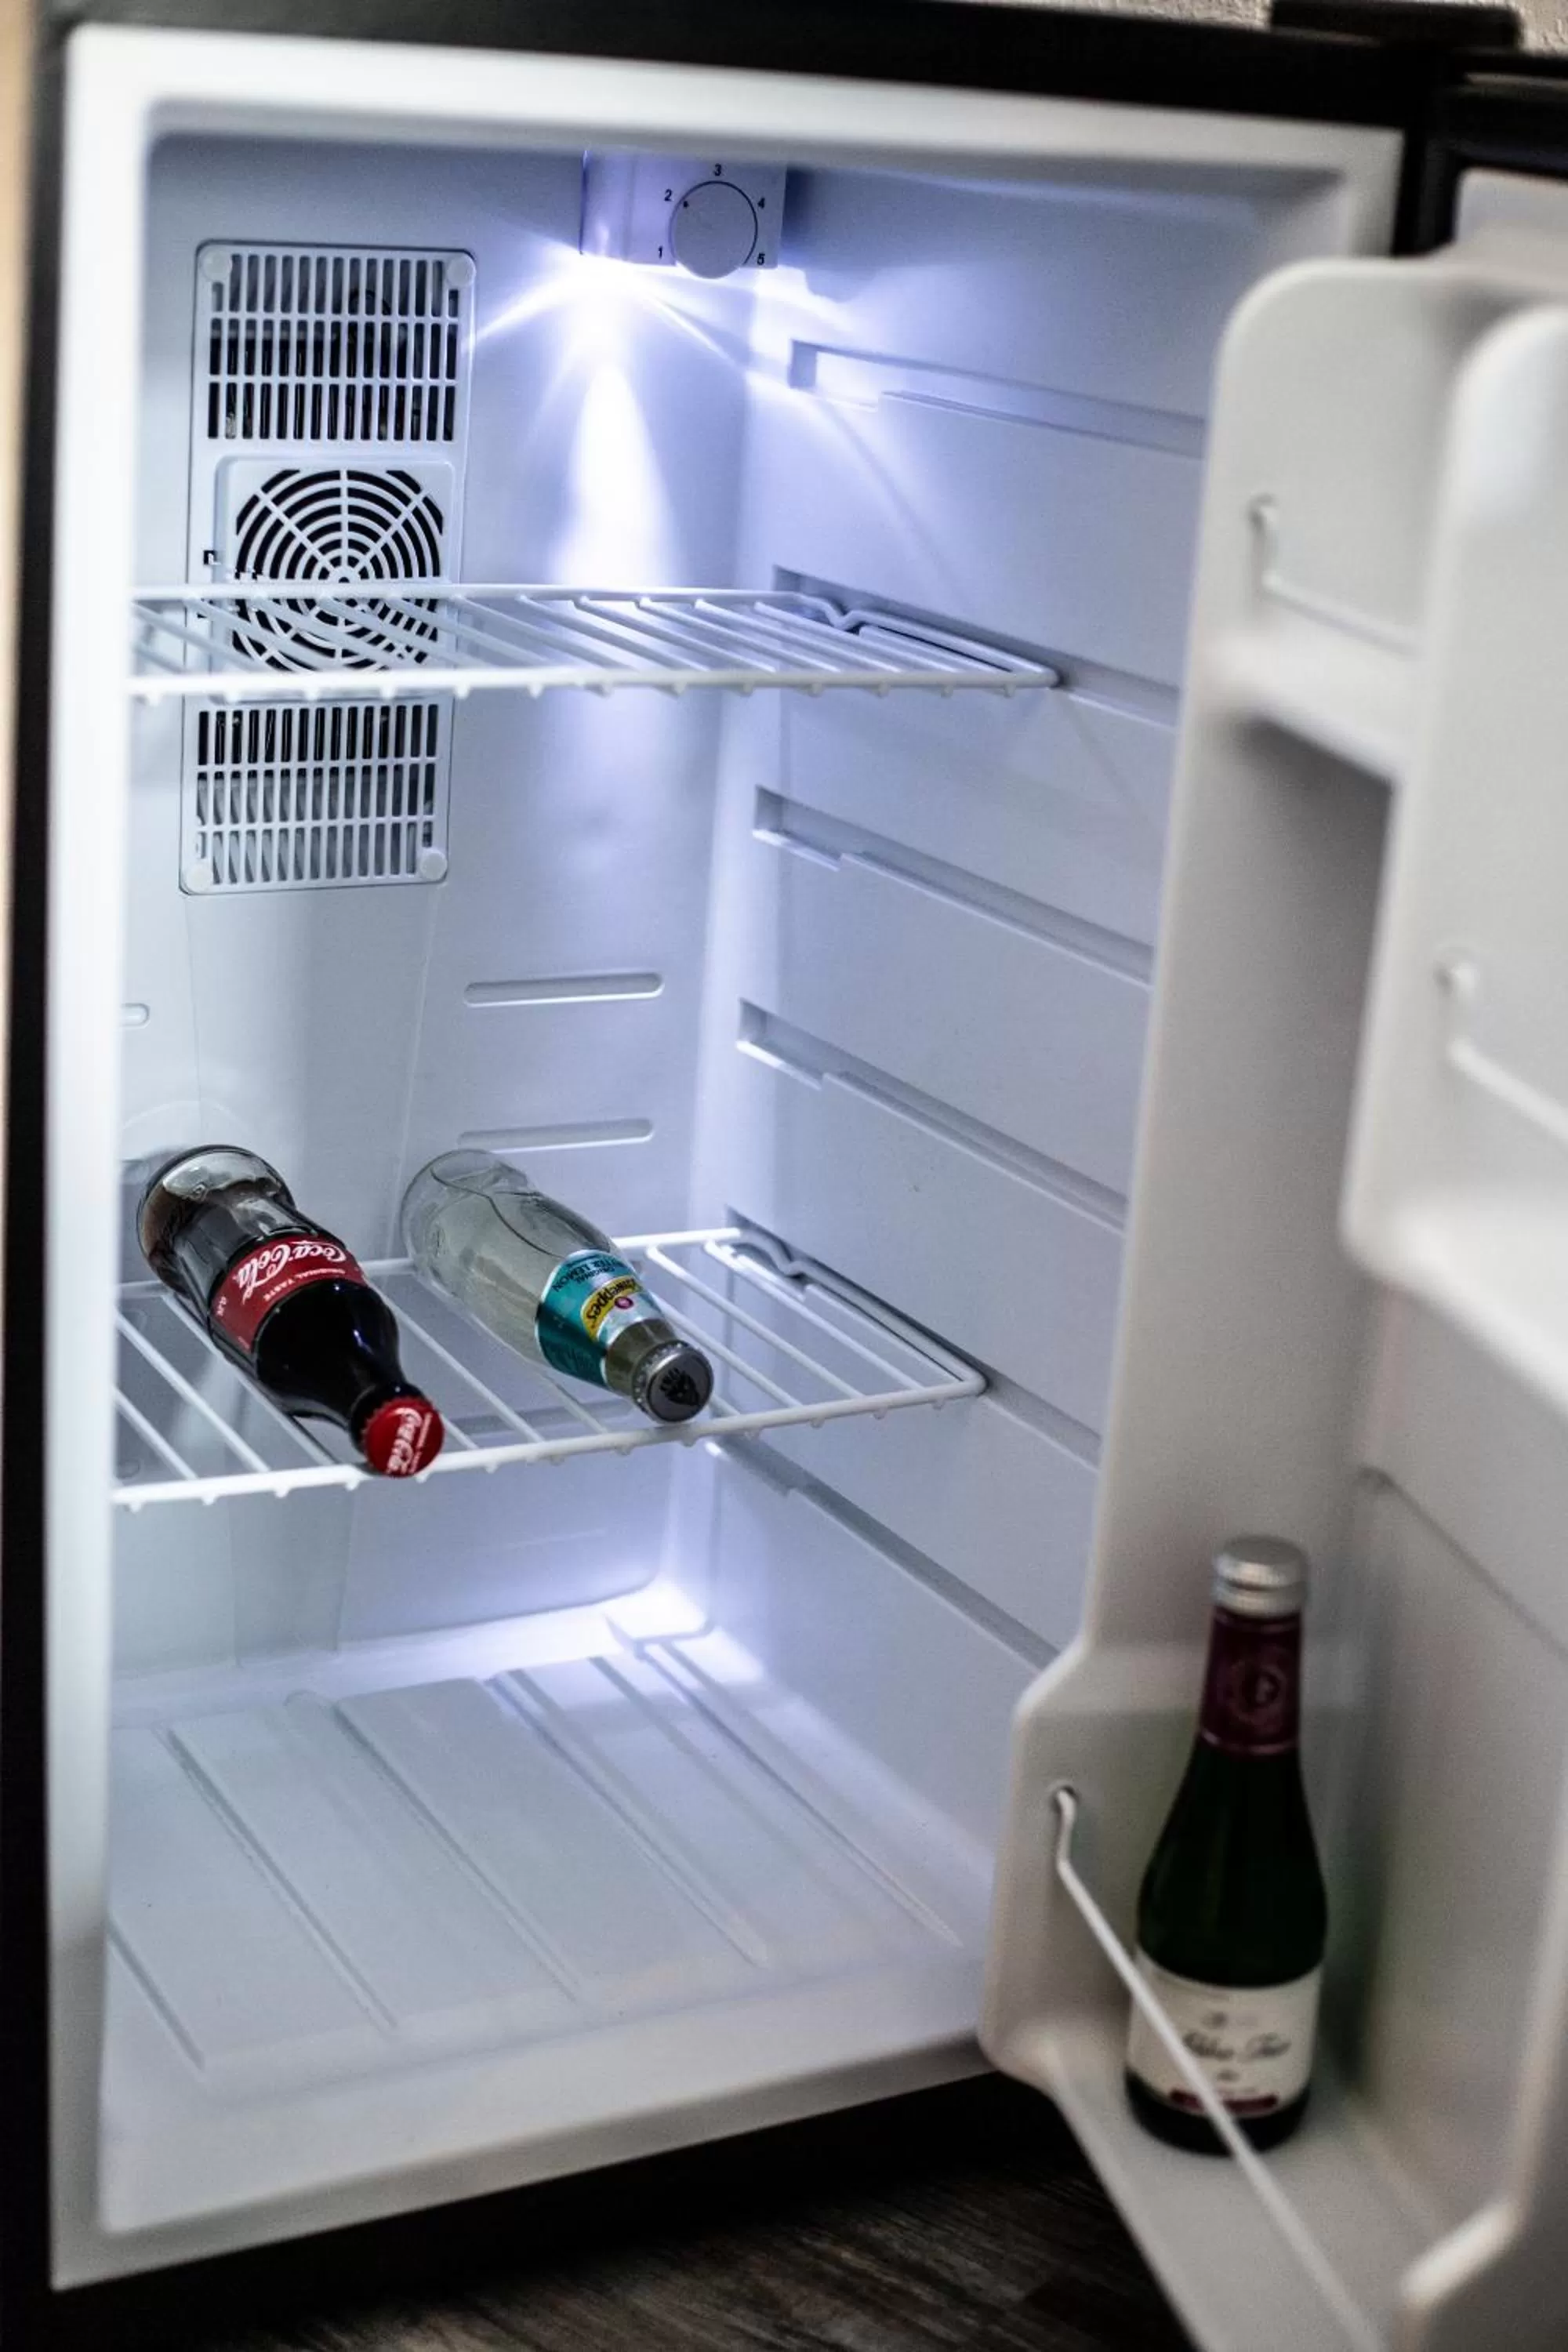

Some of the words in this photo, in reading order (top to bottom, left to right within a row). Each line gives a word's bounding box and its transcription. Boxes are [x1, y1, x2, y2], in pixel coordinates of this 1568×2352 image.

[713, 163, 722, 176] 3
[664, 188, 673, 201] 2
[757, 198, 765, 209] 4
[658, 245, 663, 258] 1
[757, 253, 765, 265] 5
[237, 1240, 347, 1305] Coca-Cola
[552, 1262, 591, 1292] LEMON
